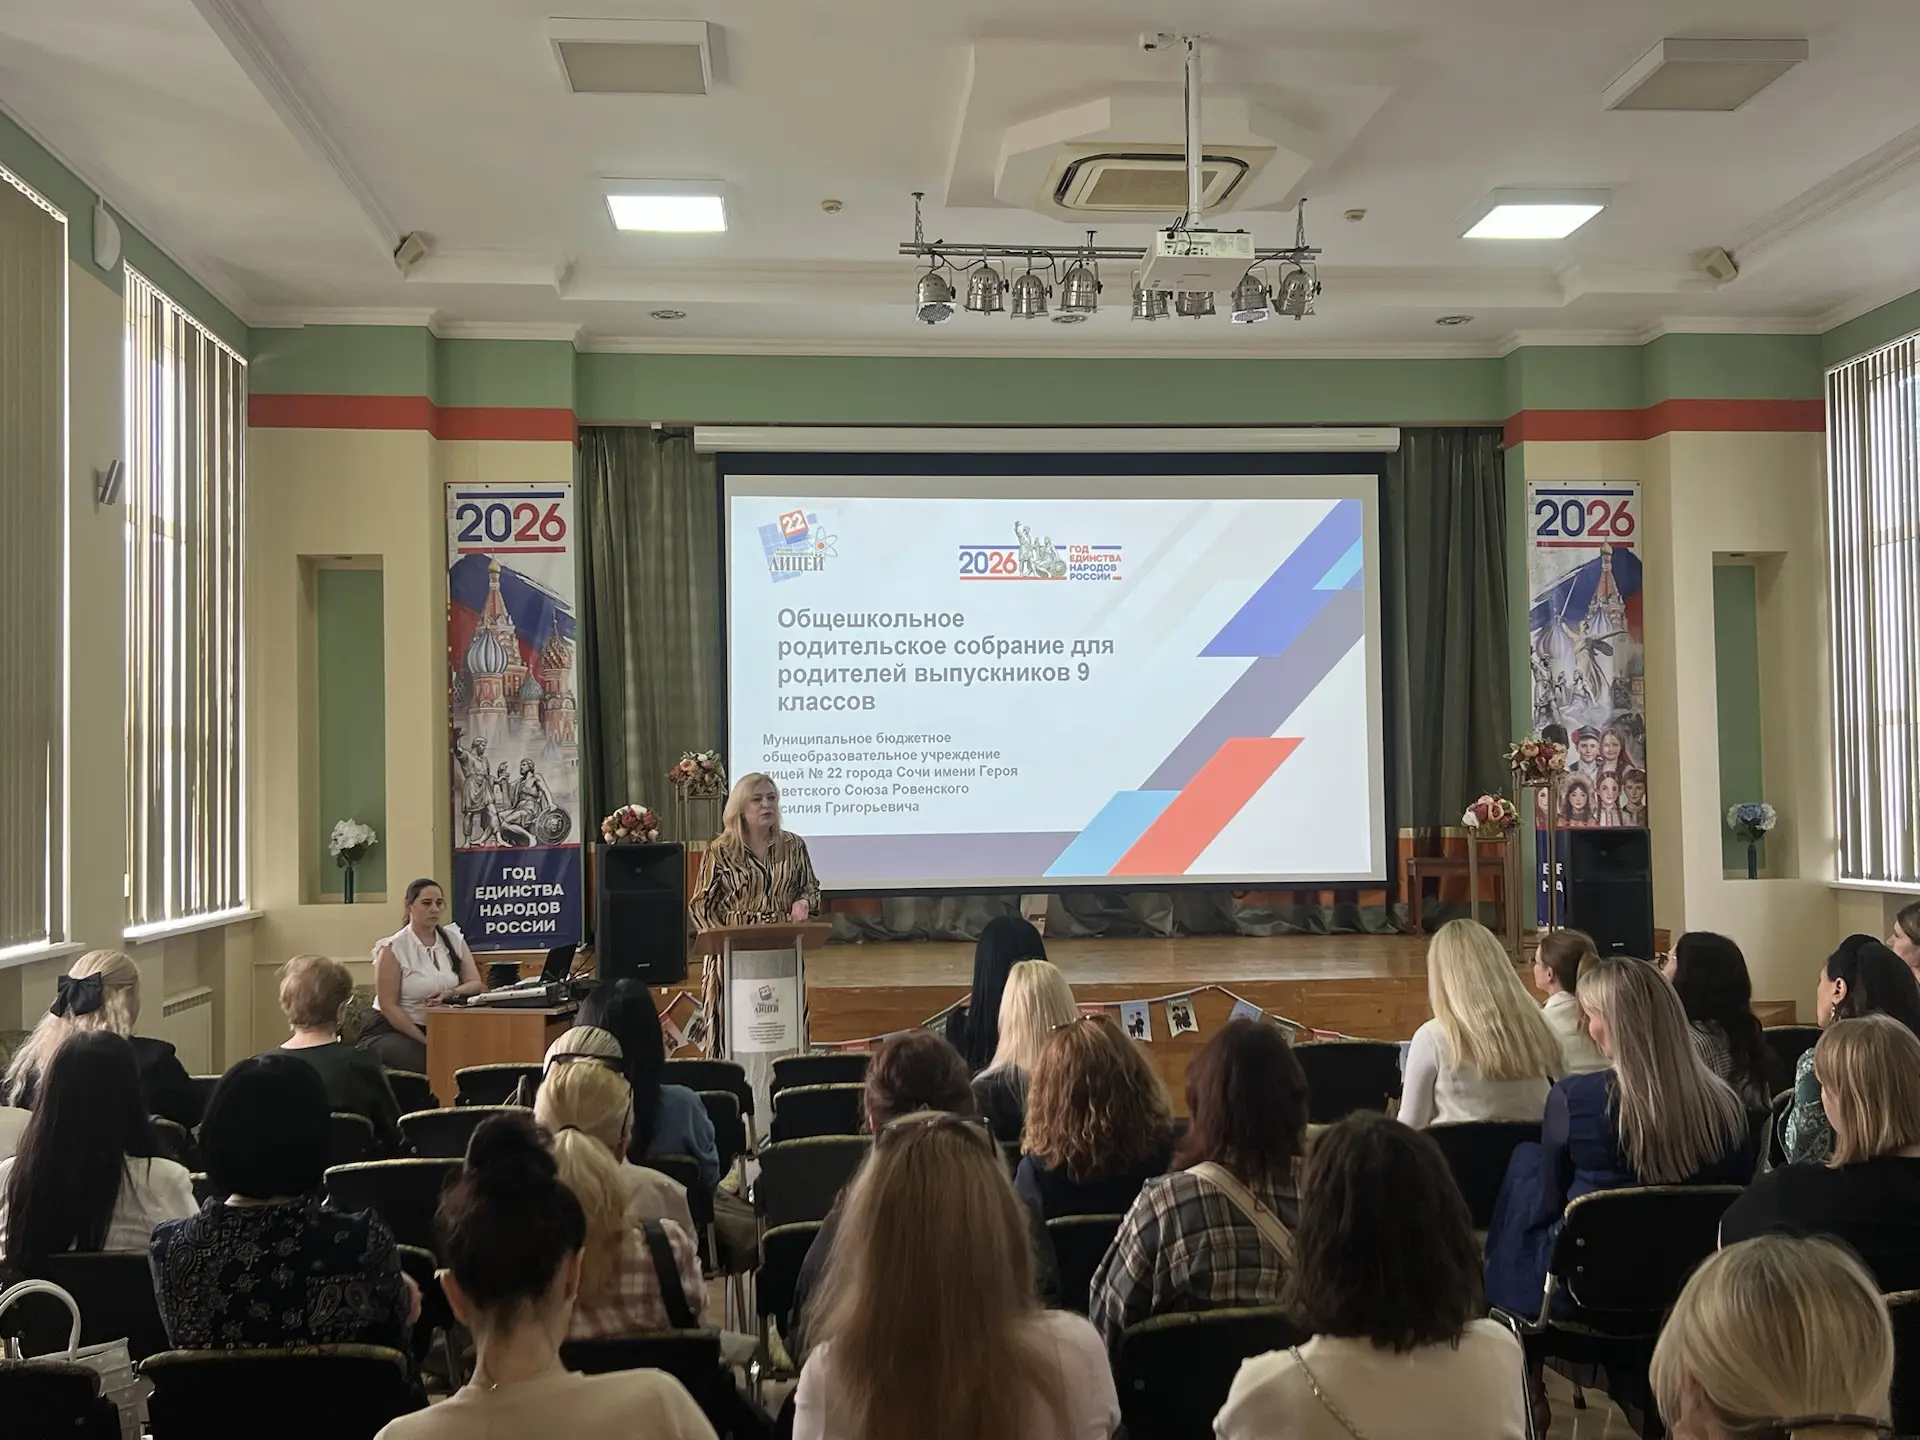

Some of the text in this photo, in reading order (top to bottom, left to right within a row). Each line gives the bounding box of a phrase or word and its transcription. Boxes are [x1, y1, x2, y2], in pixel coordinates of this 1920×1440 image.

[456, 503, 566, 542] 2026
[782, 512, 806, 534] 22
[1535, 499, 1635, 537] 2026
[1069, 545, 1089, 554] ГОД
[769, 553, 824, 574] ЛИЦЕЙ
[959, 551, 1017, 574] 2026
[1069, 554, 1122, 563] ЕДИНСТВА
[1069, 564, 1117, 572] НАРОДОВ
[1069, 573, 1111, 581] РОССИИ
[777, 607, 965, 630] Общешкольное
[777, 635, 1114, 660] родительское собрание для
[777, 663, 1090, 687] родителей выпускников 9
[777, 693, 876, 711] классов
[763, 731, 951, 746] Муниципальное бюджетное
[763, 749, 1000, 765] общеобразовательное учреждение
[808, 767, 823, 779] №
[827, 767, 842, 778] 22
[846, 767, 893, 780] города
[896, 766, 930, 778] Сочи
[934, 768, 975, 778] имени
[979, 764, 1018, 779] Героя
[779, 781, 969, 798] ветского Союза Ровенского
[779, 801, 919, 816] силия Григорьевича
[502, 867, 537, 881] ГОД
[475, 883, 564, 901] ЕДИНСТВА
[479, 901, 560, 917] НАРОДОВ
[485, 919, 556, 935] РОССИИ
